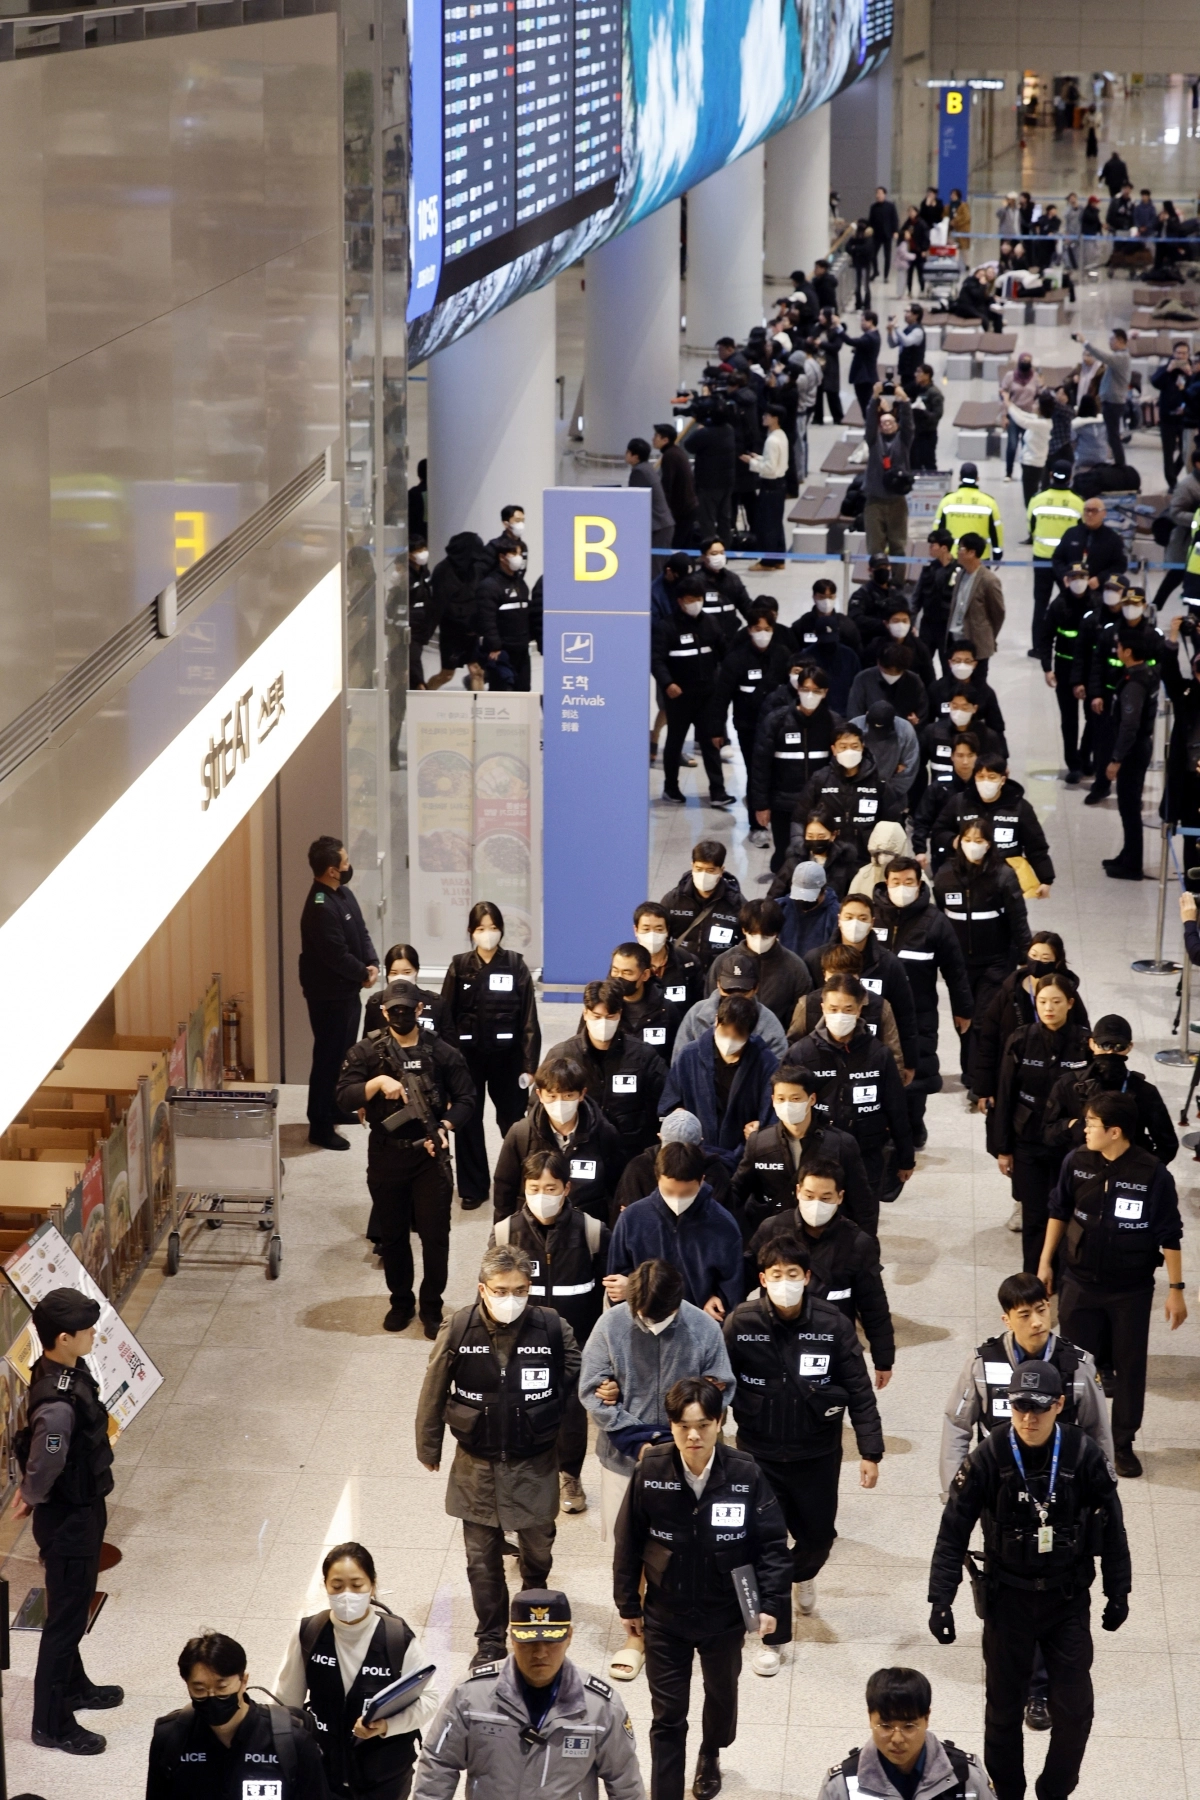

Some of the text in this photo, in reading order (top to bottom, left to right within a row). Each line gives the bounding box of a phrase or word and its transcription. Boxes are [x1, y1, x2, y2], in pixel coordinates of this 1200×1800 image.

[946, 91, 964, 115] B
[573, 515, 619, 582] B
[561, 675, 589, 691] 도착
[561, 695, 606, 706] Arrivals
[561, 710, 579, 719] 到达
[561, 722, 579, 733] 到着
[993, 815, 1019, 823] POLICE
[403, 1060, 422, 1069] LICE
[849, 1070, 880, 1080] POLICE
[1115, 1181, 1148, 1192] POLICE
[737, 1334, 771, 1343] POLICE
[798, 1333, 835, 1343] POLICE
[459, 1345, 490, 1354] OLICE
[644, 1481, 682, 1492] POLICE
[567, 1738, 588, 1750] 경찰
